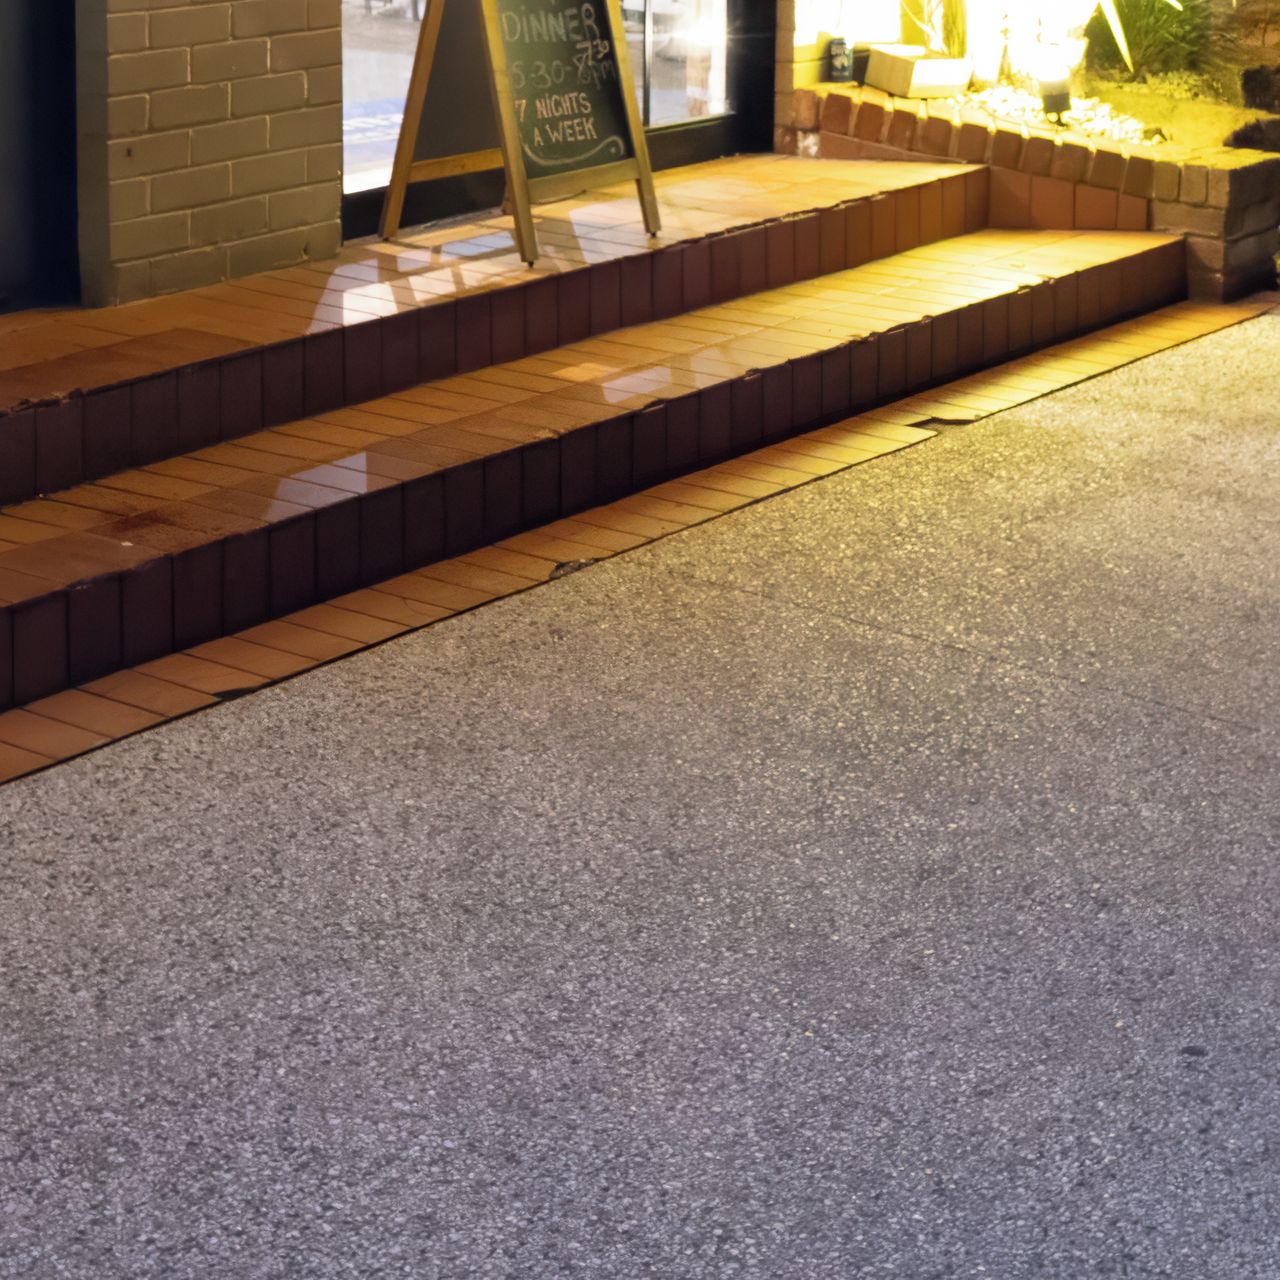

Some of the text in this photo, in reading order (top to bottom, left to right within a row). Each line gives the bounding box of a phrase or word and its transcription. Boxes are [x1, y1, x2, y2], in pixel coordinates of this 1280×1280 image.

[514, 96, 527, 122] 7
[533, 117, 598, 147] A WEEK
